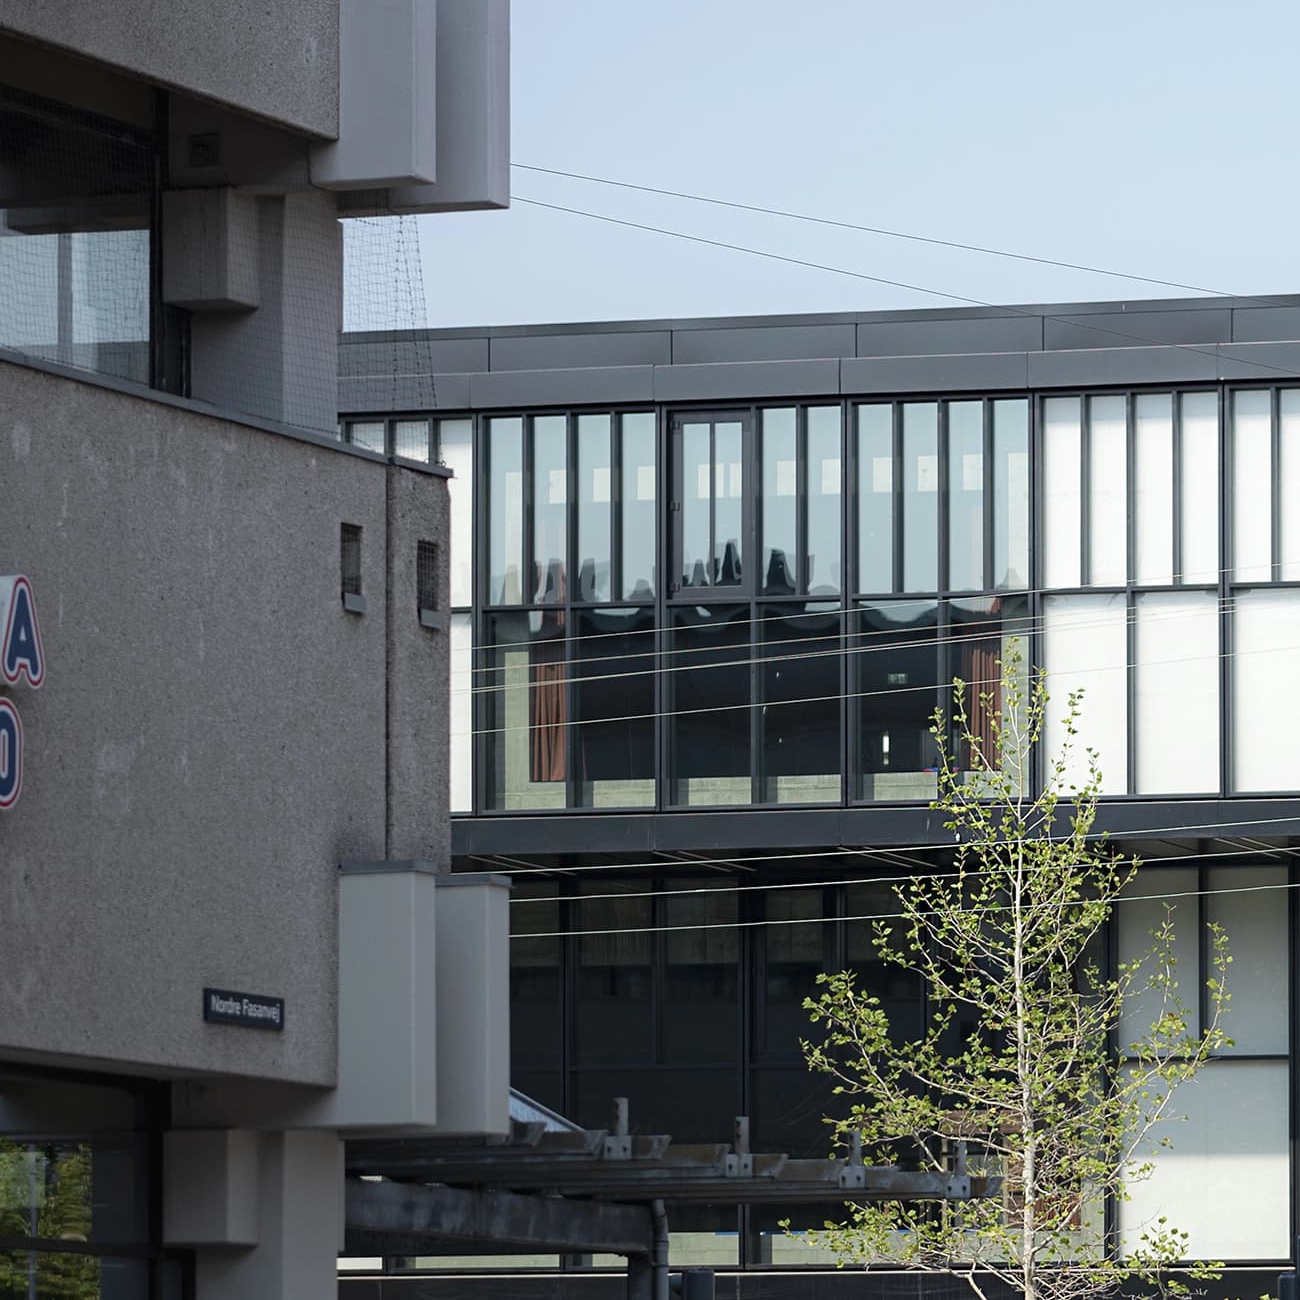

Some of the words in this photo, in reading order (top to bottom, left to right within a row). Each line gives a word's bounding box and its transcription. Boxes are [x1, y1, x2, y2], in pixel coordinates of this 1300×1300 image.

[3, 575, 45, 689] A
[210, 994, 241, 1016] Nordre
[242, 998, 280, 1023] Fasanvej
